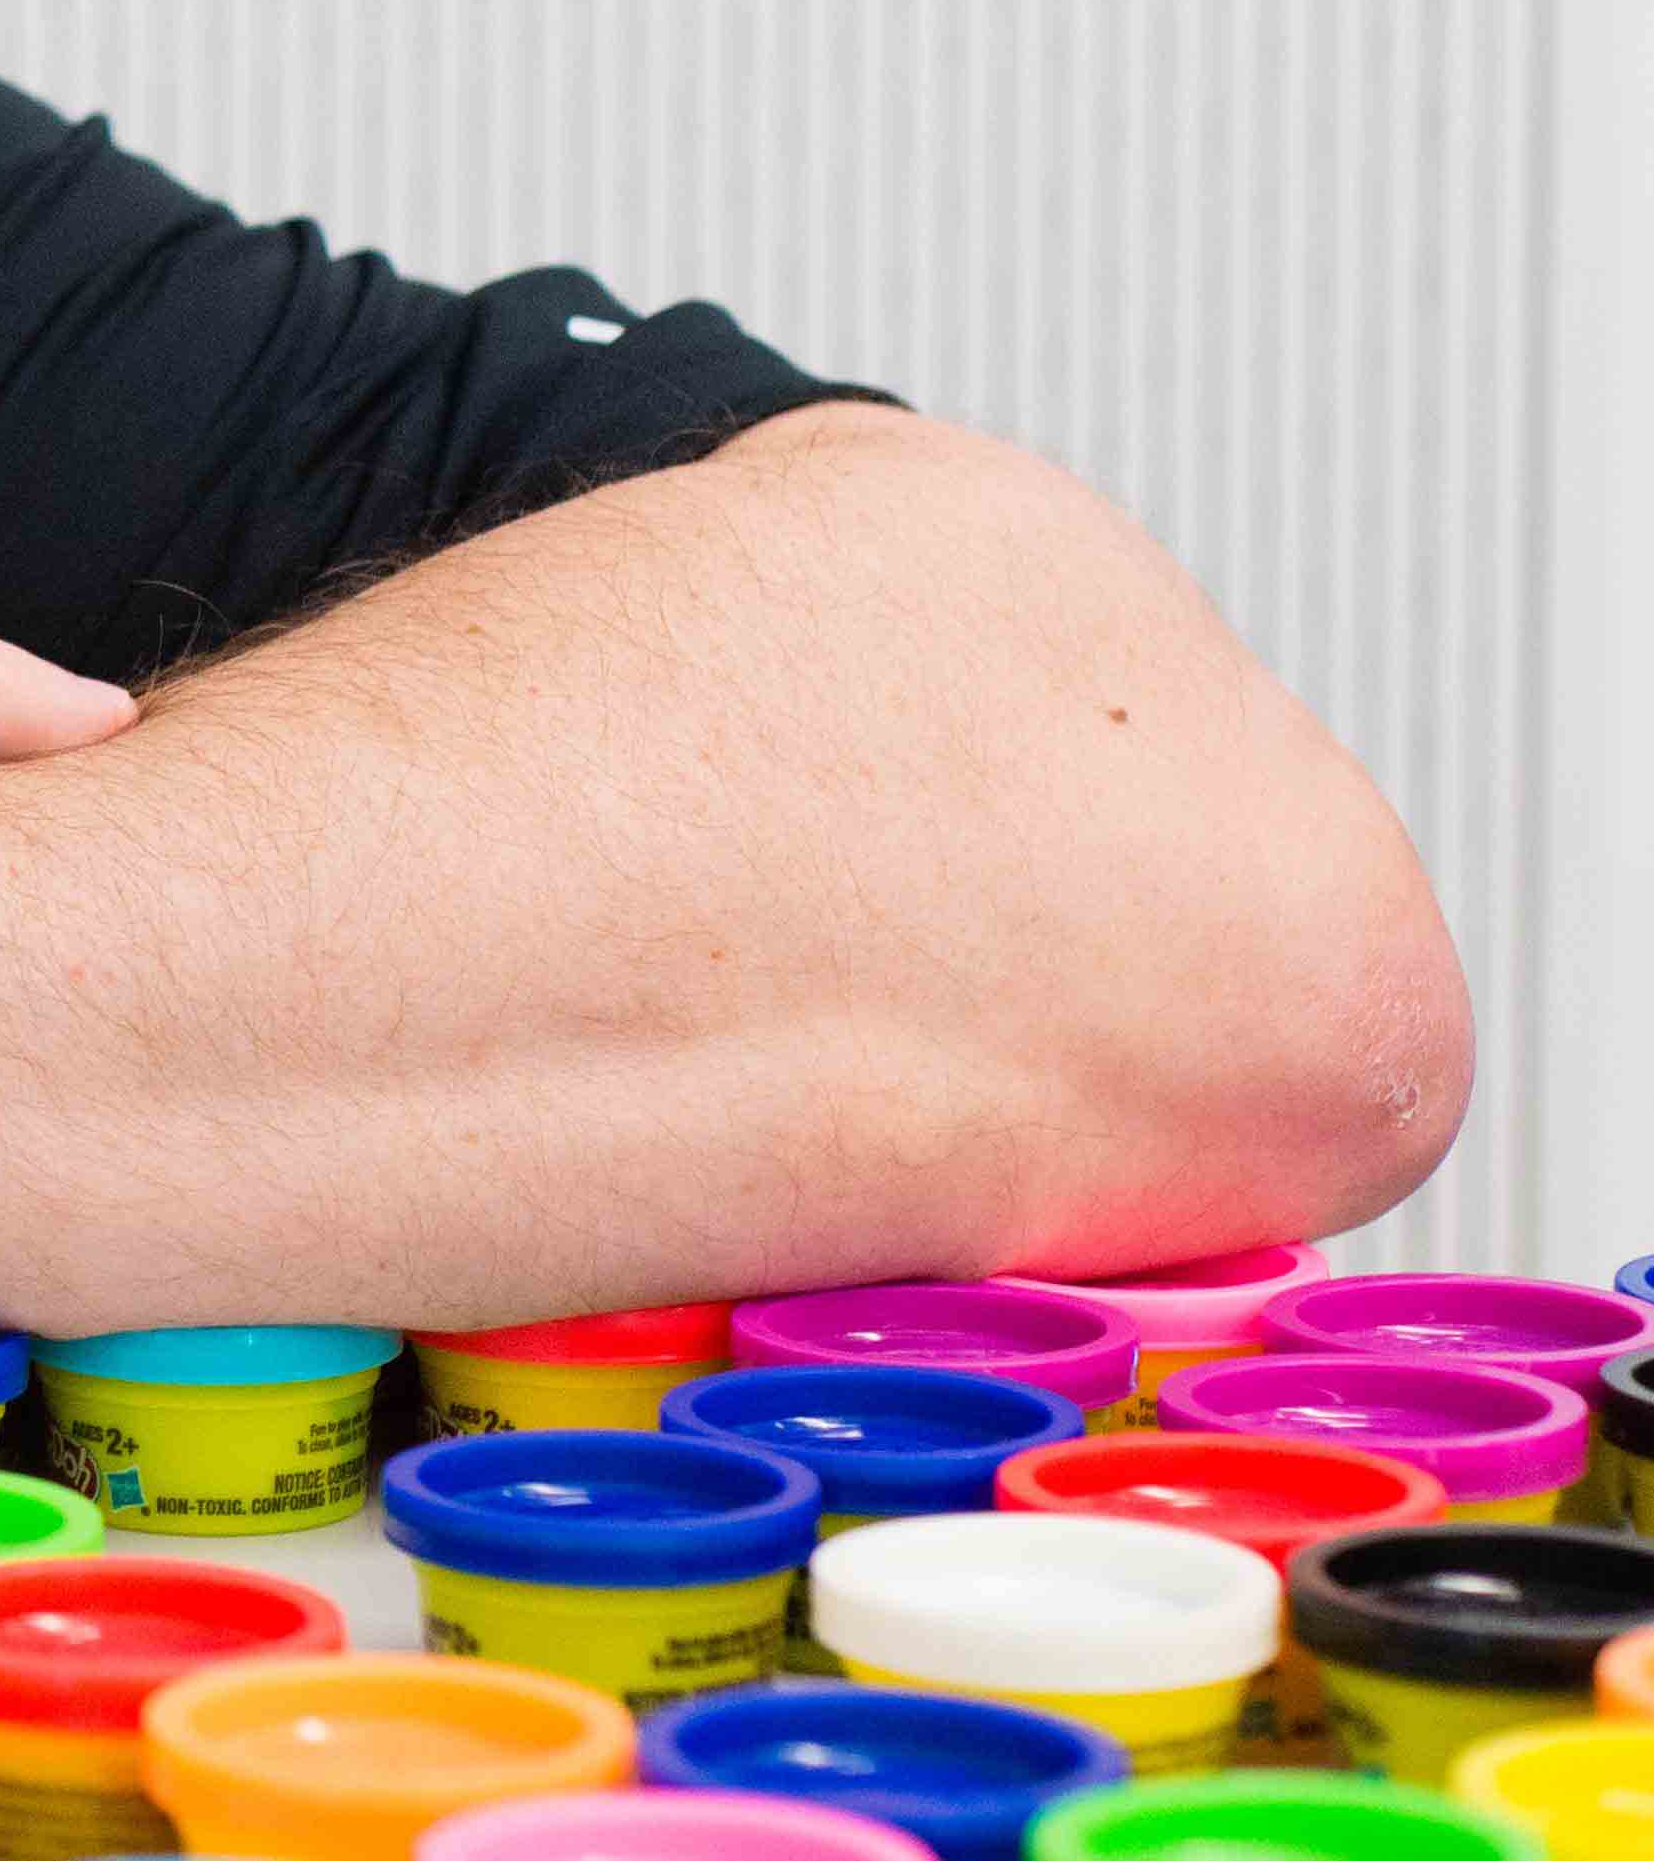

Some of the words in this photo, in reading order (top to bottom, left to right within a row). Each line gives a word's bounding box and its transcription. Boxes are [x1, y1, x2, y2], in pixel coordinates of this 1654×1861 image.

[72, 1419, 104, 1443] AGES
[106, 1427, 140, 1457] 2+
[251, 1490, 326, 1515] CONFORMS
[328, 1485, 342, 1504] TO
